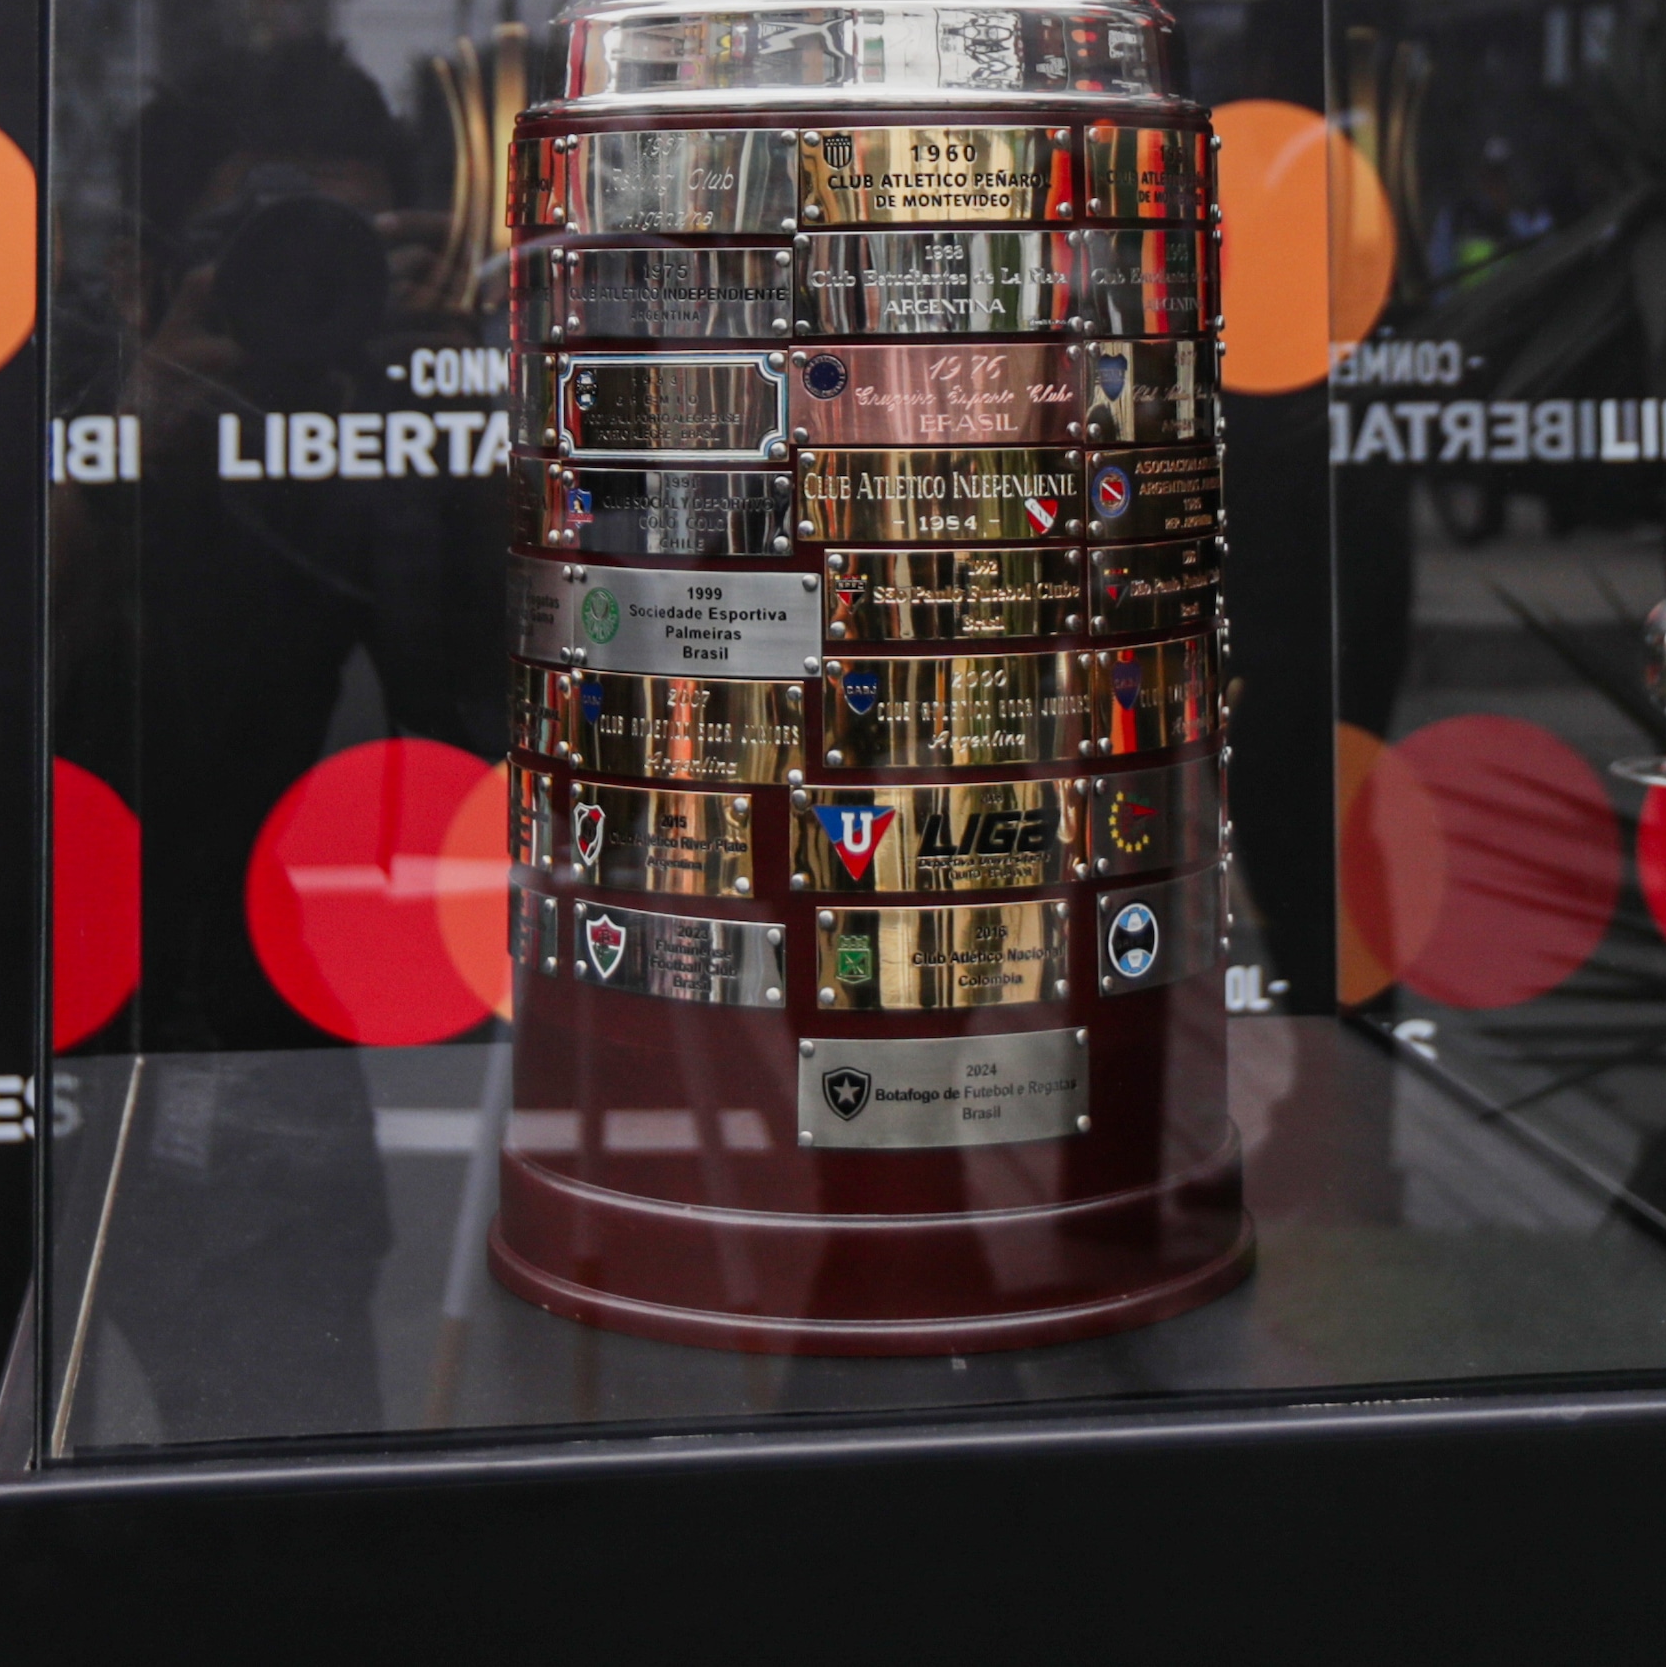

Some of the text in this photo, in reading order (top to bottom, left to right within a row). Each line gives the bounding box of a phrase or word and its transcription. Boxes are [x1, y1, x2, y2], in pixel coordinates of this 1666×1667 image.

[910, 144, 977, 163] 1960
[688, 165, 734, 191] Club
[827, 173, 874, 190] CLUB
[880, 172, 967, 189] ATLETICO
[876, 193, 1011, 208] DE MONTEVIDEO
[663, 286, 790, 302] INDEPENDIENTE
[884, 297, 1007, 316] ARGENTINA
[920, 413, 1018, 432] BRASIL
[218, 411, 511, 480] LIBERTA
[659, 537, 705, 550] CHILE
[687, 586, 723, 601] 1999
[629, 604, 787, 624] Sociedade Esportiva
[665, 625, 742, 641] Palmeiras
[683, 646, 729, 660] Brasil
[952, 669, 1008, 688] 2000
[660, 815, 687, 829] 2015
[681, 837, 712, 851] River
[715, 839, 748, 852] Plate
[975, 925, 1008, 941] 2016
[912, 951, 946, 966] Club
[958, 972, 1024, 988] Colombia
[965, 1064, 997, 1078] 2024
[875, 1078, 1077, 1103] Botafogo de Futebol e Regatas
[962, 1105, 1001, 1121] Brasil
